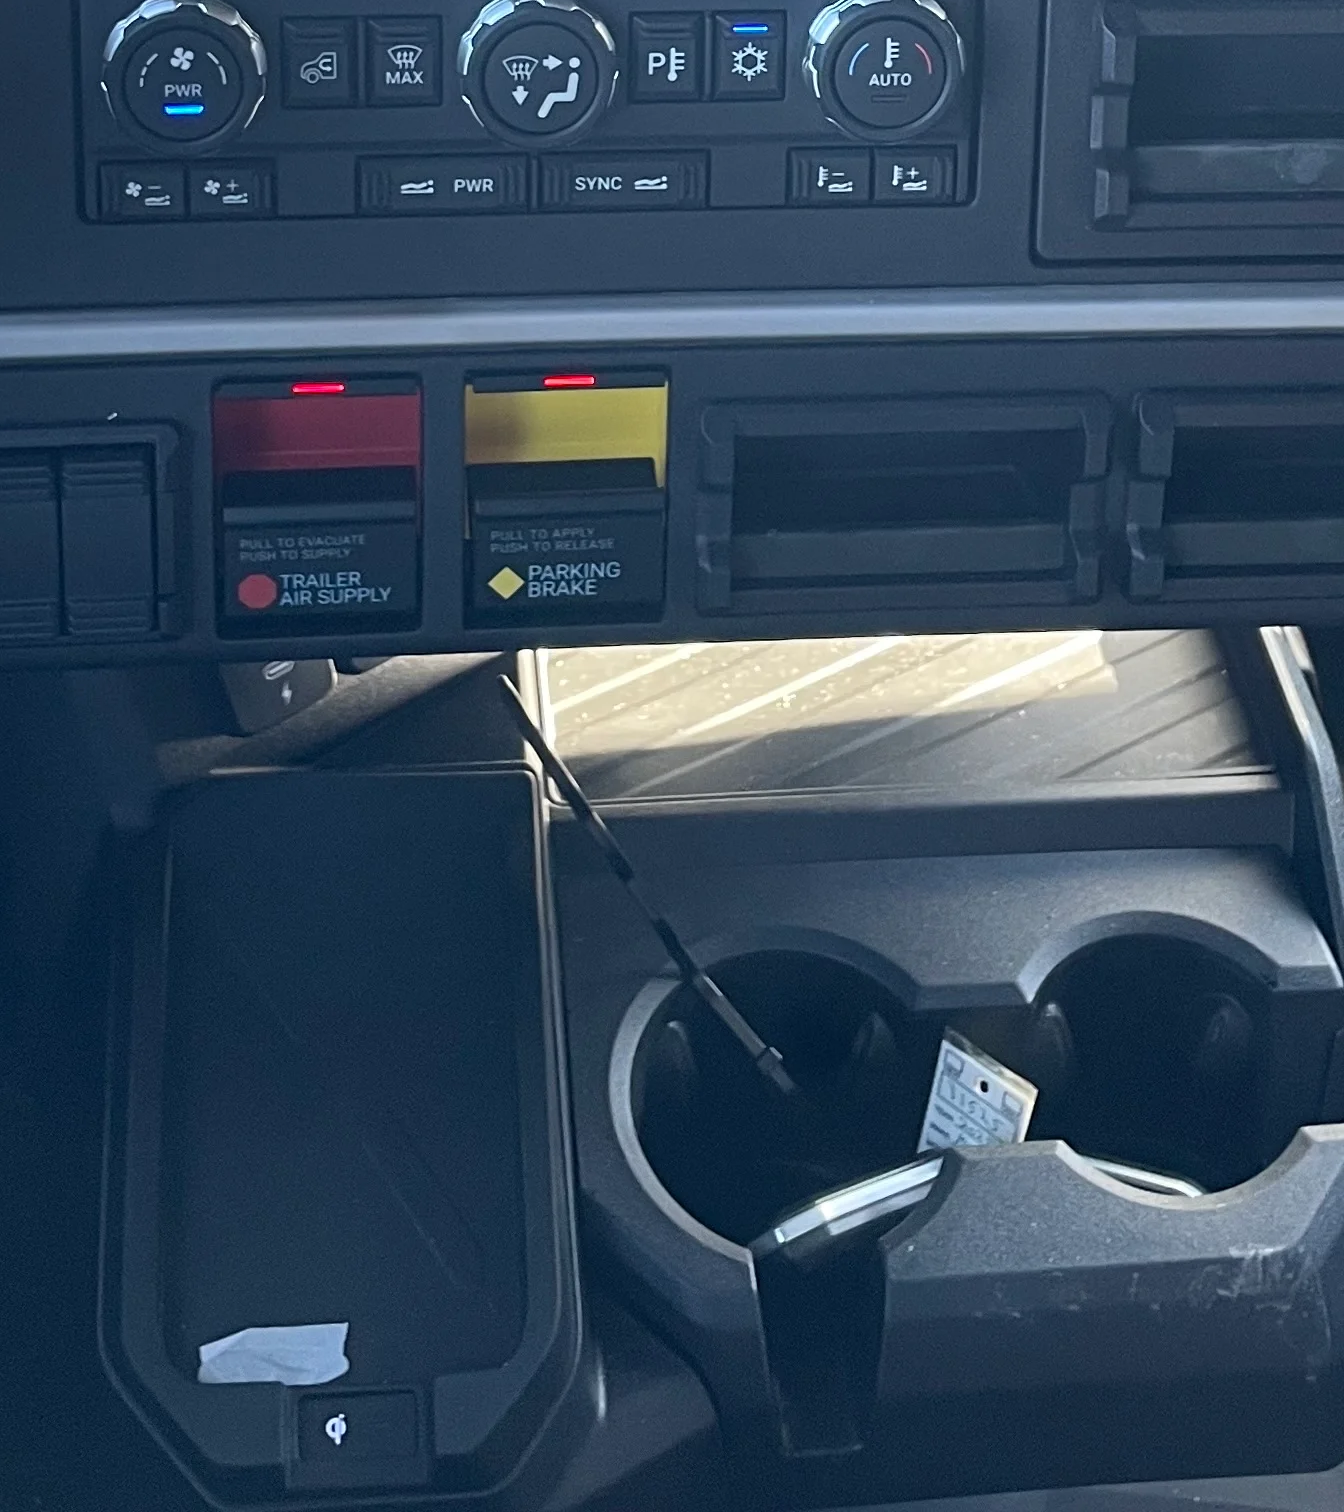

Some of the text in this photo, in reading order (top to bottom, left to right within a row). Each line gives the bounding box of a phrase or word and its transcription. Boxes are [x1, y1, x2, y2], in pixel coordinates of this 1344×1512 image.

[385, 71, 424, 85] MAX
[868, 72, 912, 87] AUTO
[164, 84, 203, 98] PWR
[454, 178, 494, 193] PWR
[574, 176, 623, 191] SYNC
[239, 534, 365, 549] PULL TO EVACUATE
[490, 527, 595, 541] PULL TO APPLY
[490, 538, 615, 553] PUSH TO RELEASE
[239, 548, 352, 562] PUSH TO SUPPLY
[528, 561, 622, 581] PARKING
[279, 571, 362, 589] TRAILER
[528, 578, 598, 598] BRAKE
[279, 586, 392, 606] AIR SUPPLY
